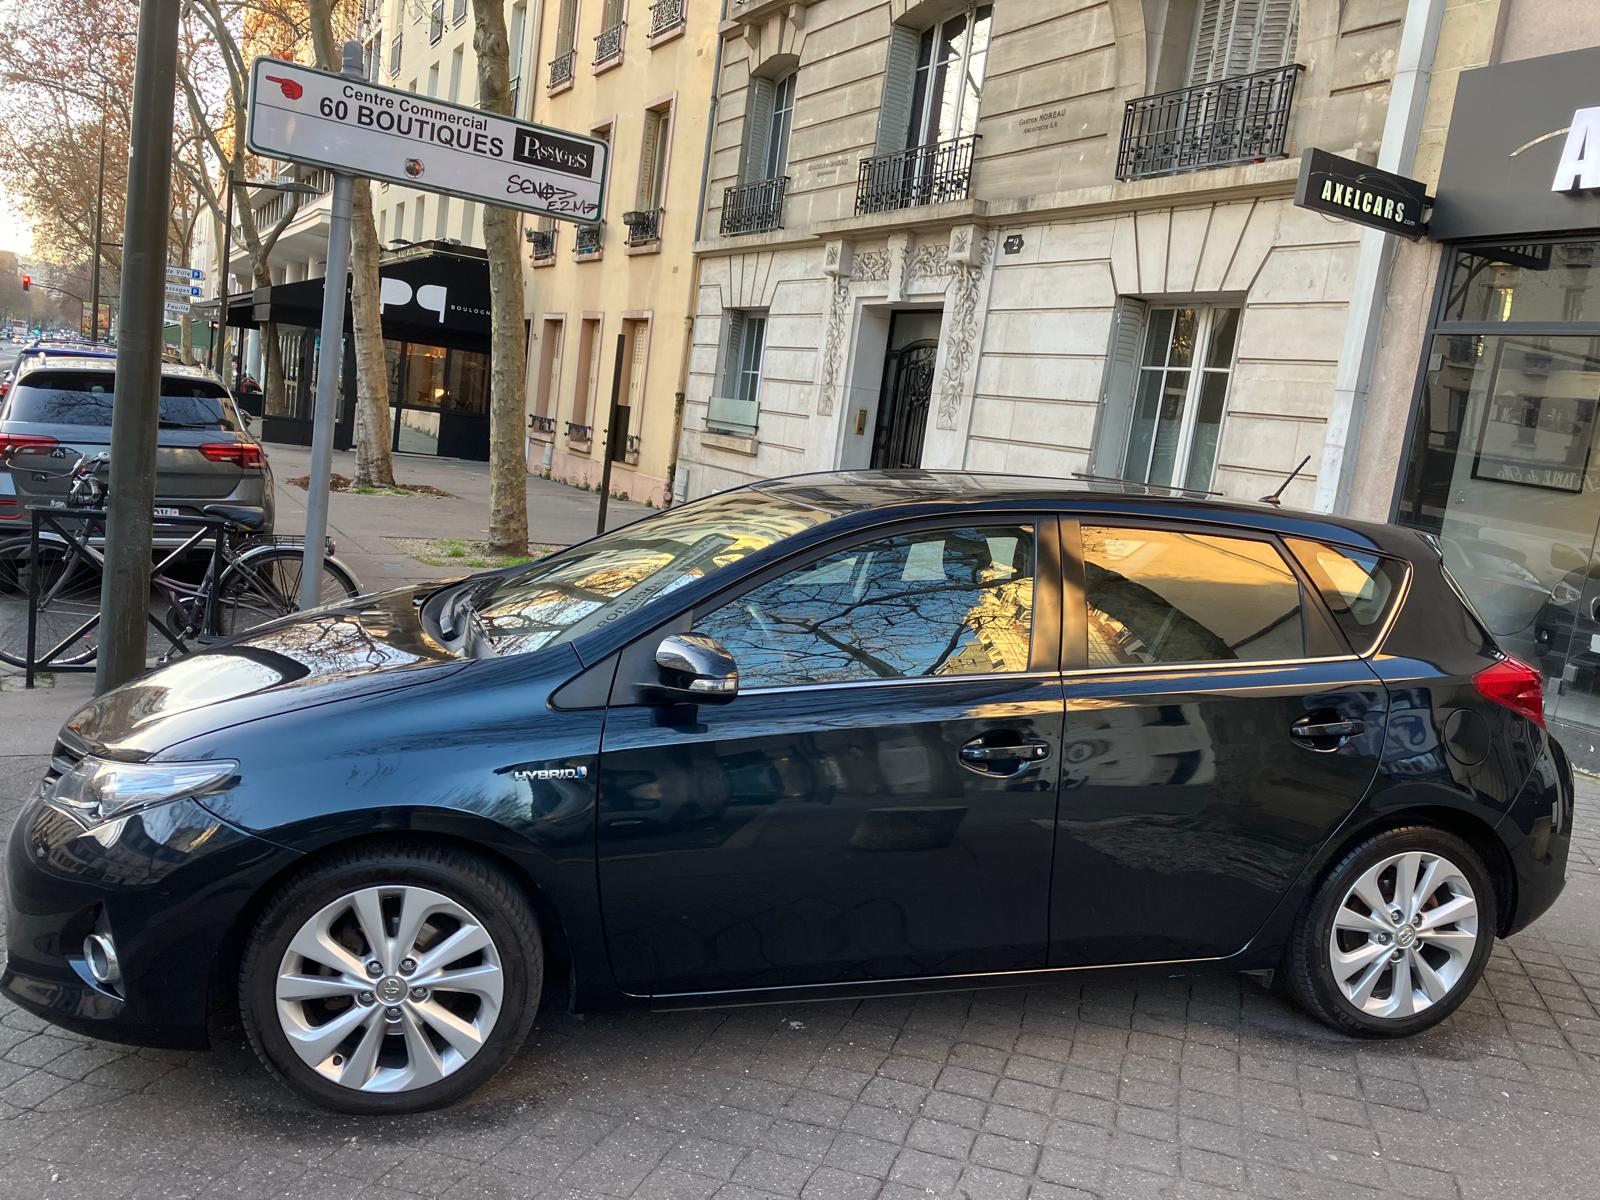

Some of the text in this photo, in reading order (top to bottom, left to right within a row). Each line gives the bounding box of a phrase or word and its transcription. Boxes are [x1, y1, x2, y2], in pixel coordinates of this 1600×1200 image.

[343, 85, 488, 132] Centre Commercial
[319, 96, 504, 158] 60 BOUTIQUES
[176, 268, 190, 276] Ville
[514, 768, 577, 781] HYBRID
